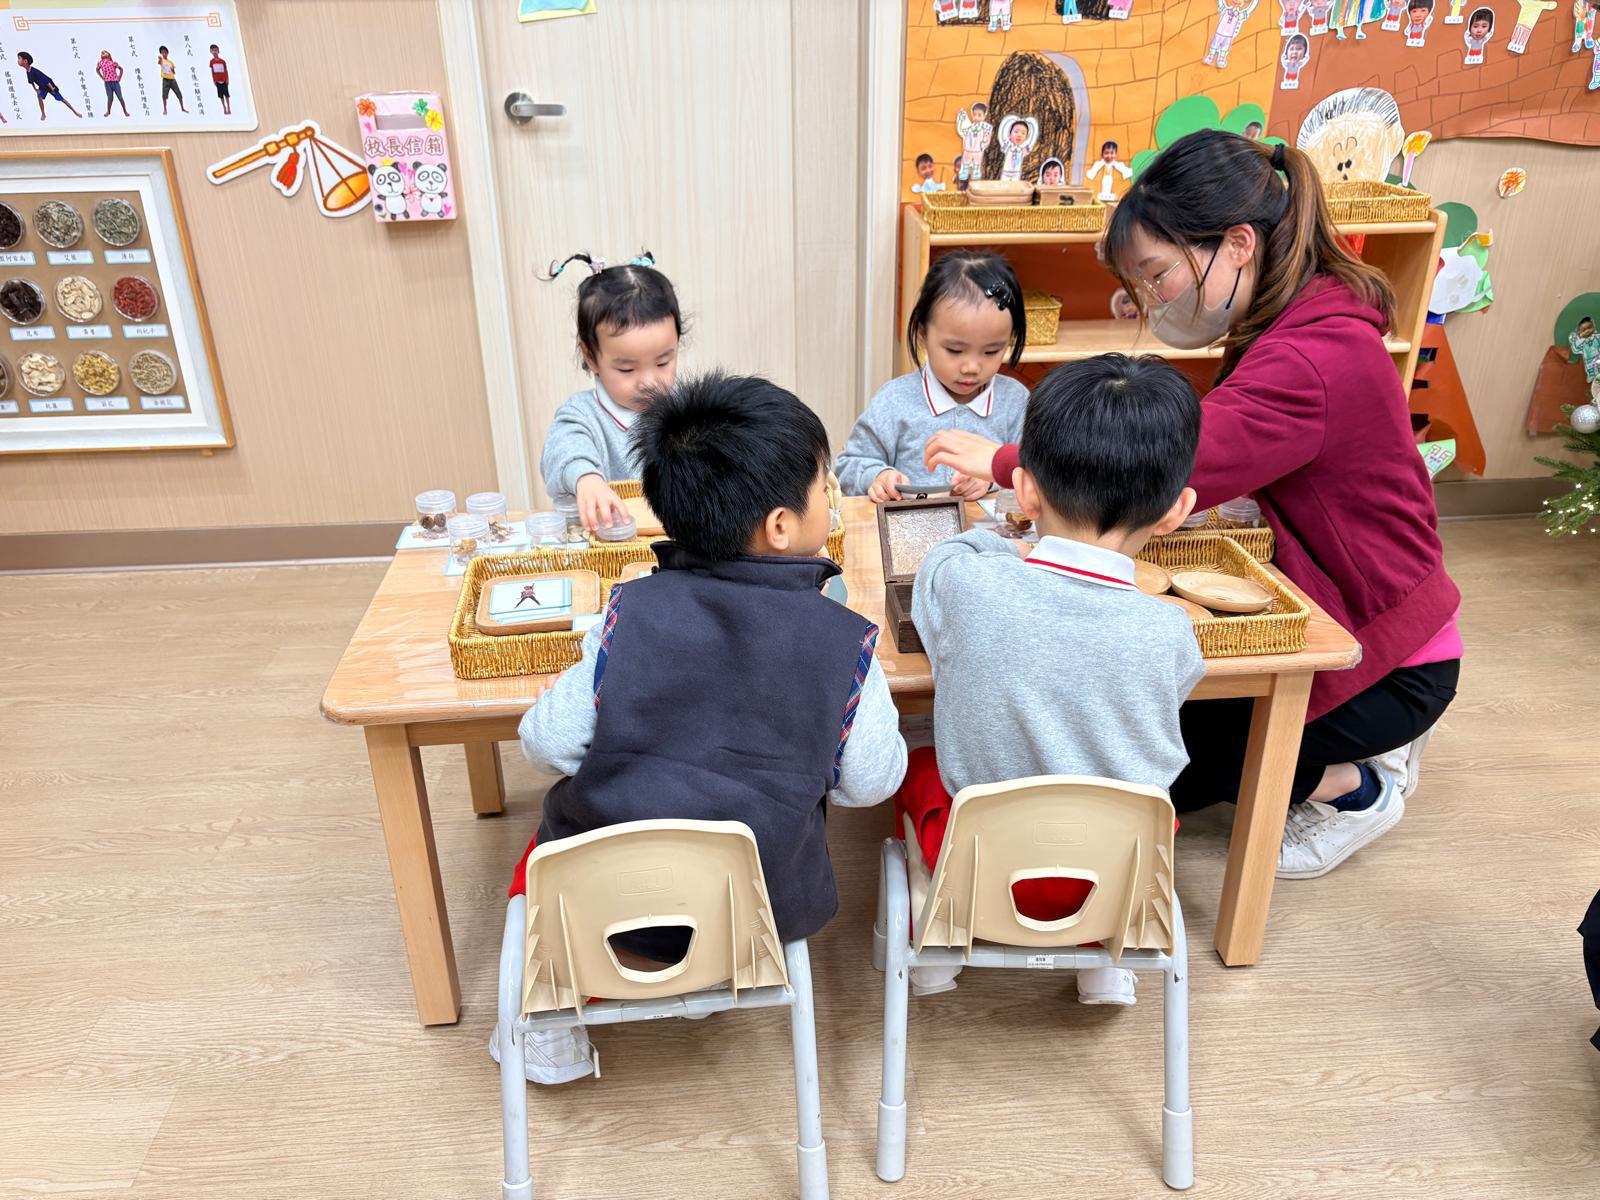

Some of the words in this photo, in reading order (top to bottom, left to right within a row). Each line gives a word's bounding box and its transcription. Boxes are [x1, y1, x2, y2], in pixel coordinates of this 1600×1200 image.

[70, 37, 81, 59] 第六式
[128, 36, 138, 58] 第七式
[184, 35, 194, 57] 第八式
[365, 135, 444, 157] 校長信箱
